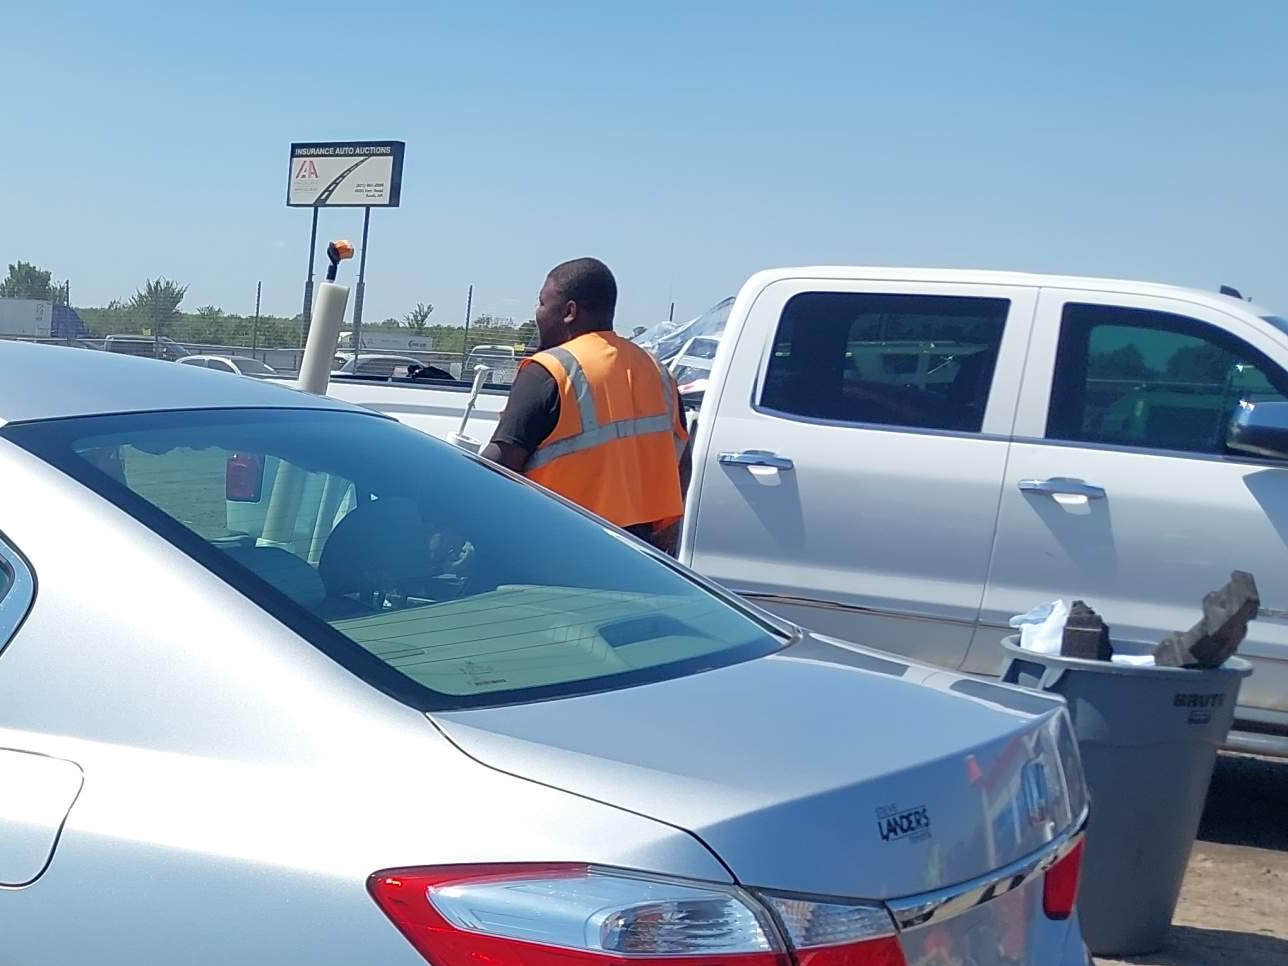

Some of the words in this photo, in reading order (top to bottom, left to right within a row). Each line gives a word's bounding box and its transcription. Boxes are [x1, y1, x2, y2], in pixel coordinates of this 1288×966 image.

[295, 147, 334, 155] INSURANCE
[335, 147, 354, 155] AUTO
[355, 146, 391, 154] AUCTIONS
[877, 808, 930, 842] LANDERS
